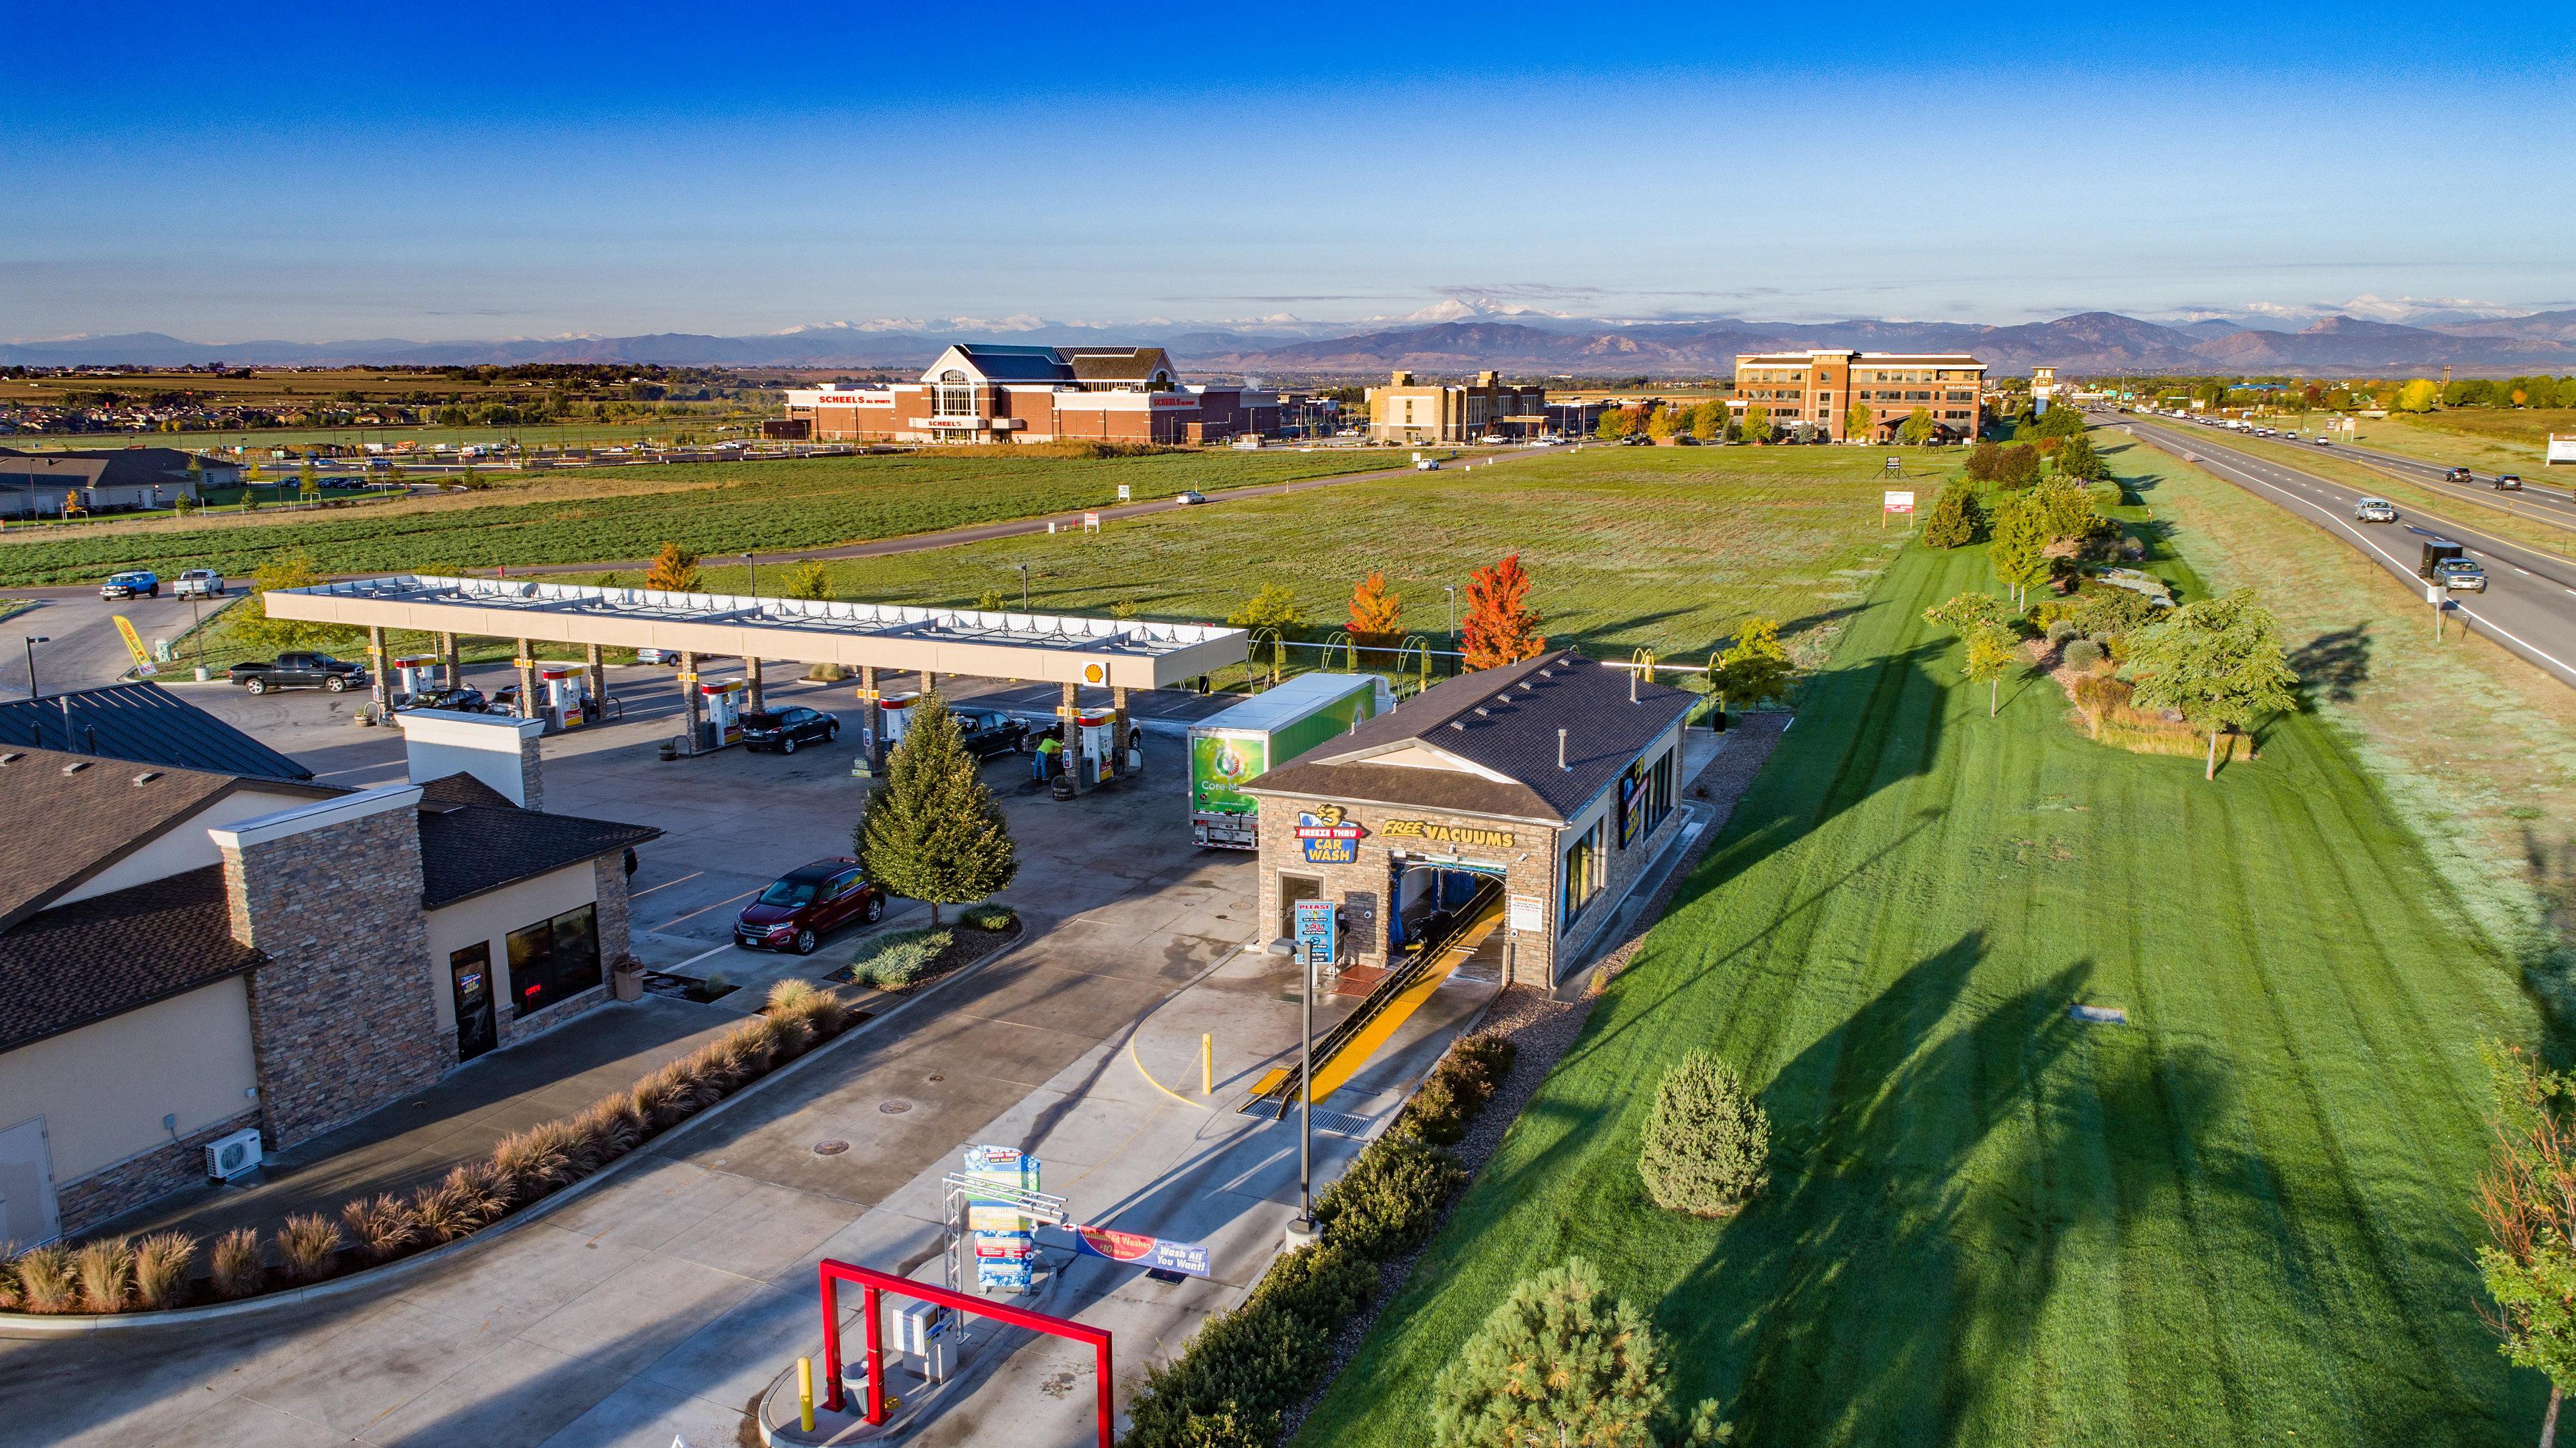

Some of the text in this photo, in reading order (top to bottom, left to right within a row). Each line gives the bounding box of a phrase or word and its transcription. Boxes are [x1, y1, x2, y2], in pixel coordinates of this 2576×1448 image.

[1153, 397, 1181, 407] SCHEELS
[1316, 804, 1341, 827] $3
[1380, 820, 1514, 847] FREE VACUUMS
[1314, 839, 1342, 850] CAR
[1308, 850, 1350, 861] WASH
[525, 984, 541, 996] OPEN
[1084, 1230, 1120, 1243] Unlimited
[1099, 1243, 1113, 1253] $10
[1160, 1246, 1202, 1262] Wash All
[1157, 1255, 1206, 1272] You Want!
